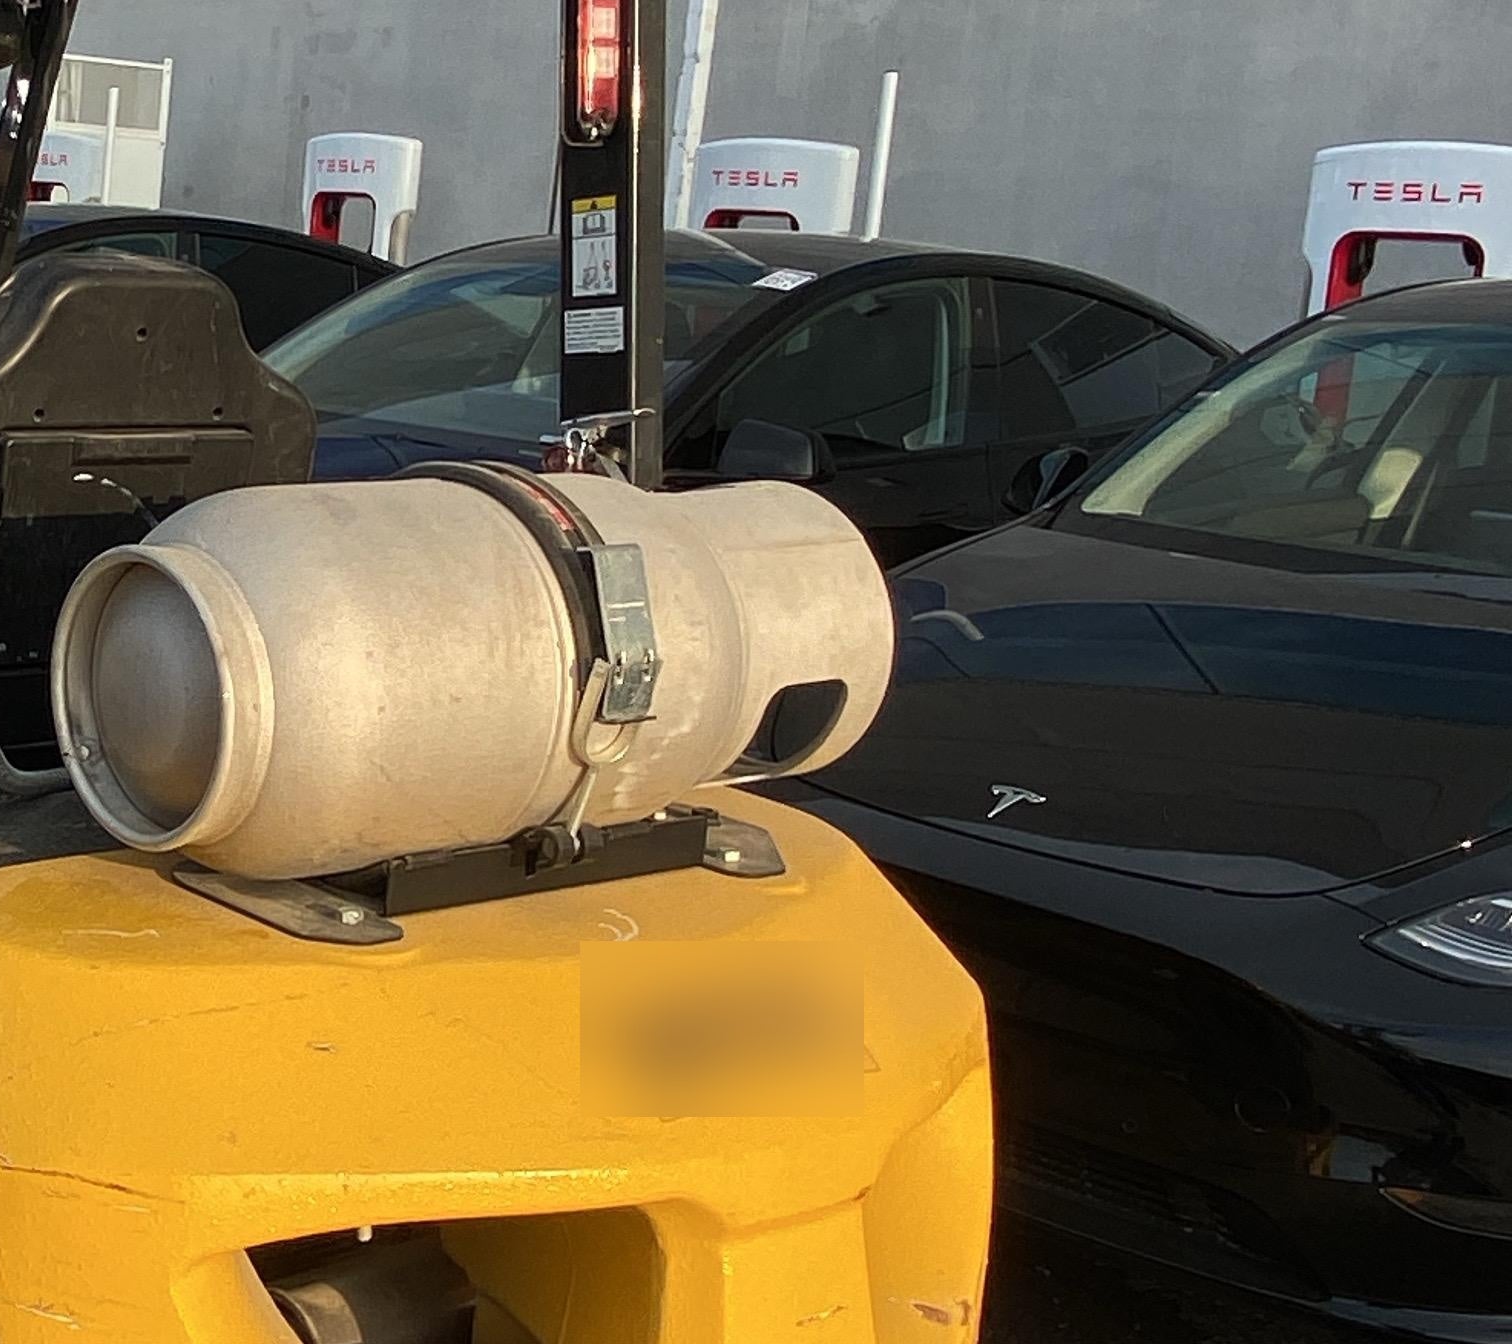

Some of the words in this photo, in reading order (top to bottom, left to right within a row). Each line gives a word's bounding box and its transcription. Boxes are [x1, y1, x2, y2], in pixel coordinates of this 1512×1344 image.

[316, 158, 376, 174] TESLA
[711, 169, 799, 188] TESLA
[1345, 181, 1484, 204] TESLA
